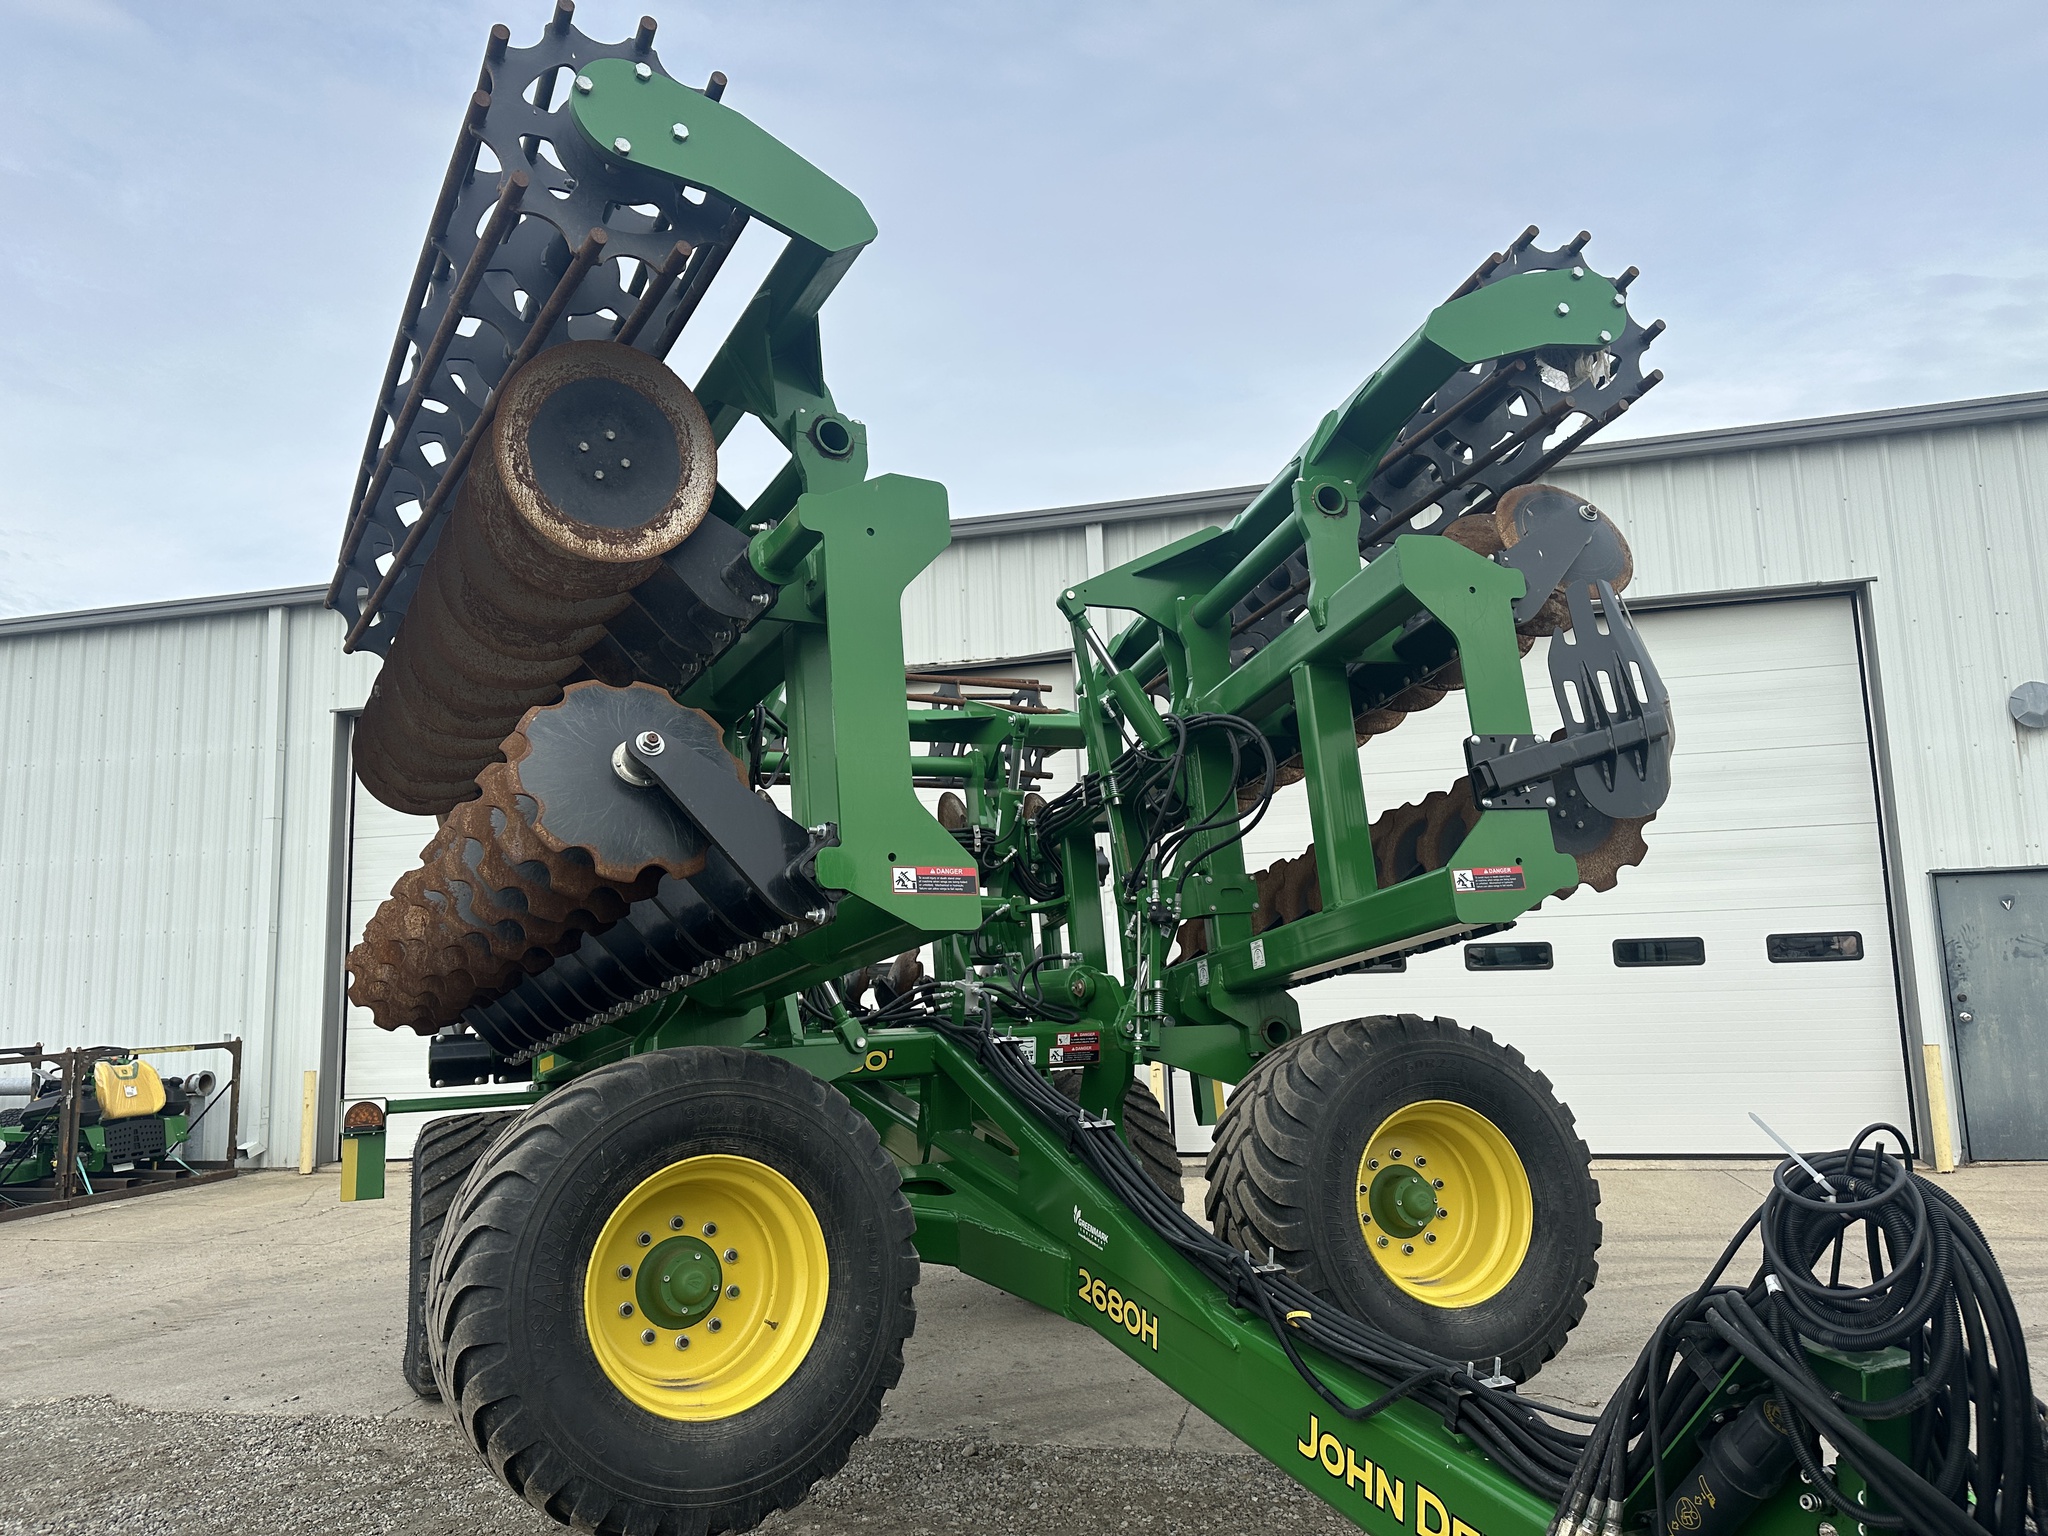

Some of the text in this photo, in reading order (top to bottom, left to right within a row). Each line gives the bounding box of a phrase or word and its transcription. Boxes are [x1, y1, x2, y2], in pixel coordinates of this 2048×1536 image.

[532, 1138, 628, 1313] ALLIANCE
[1078, 1267, 1158, 1351] 2680H
[1298, 1414, 1404, 1523] JOHN
